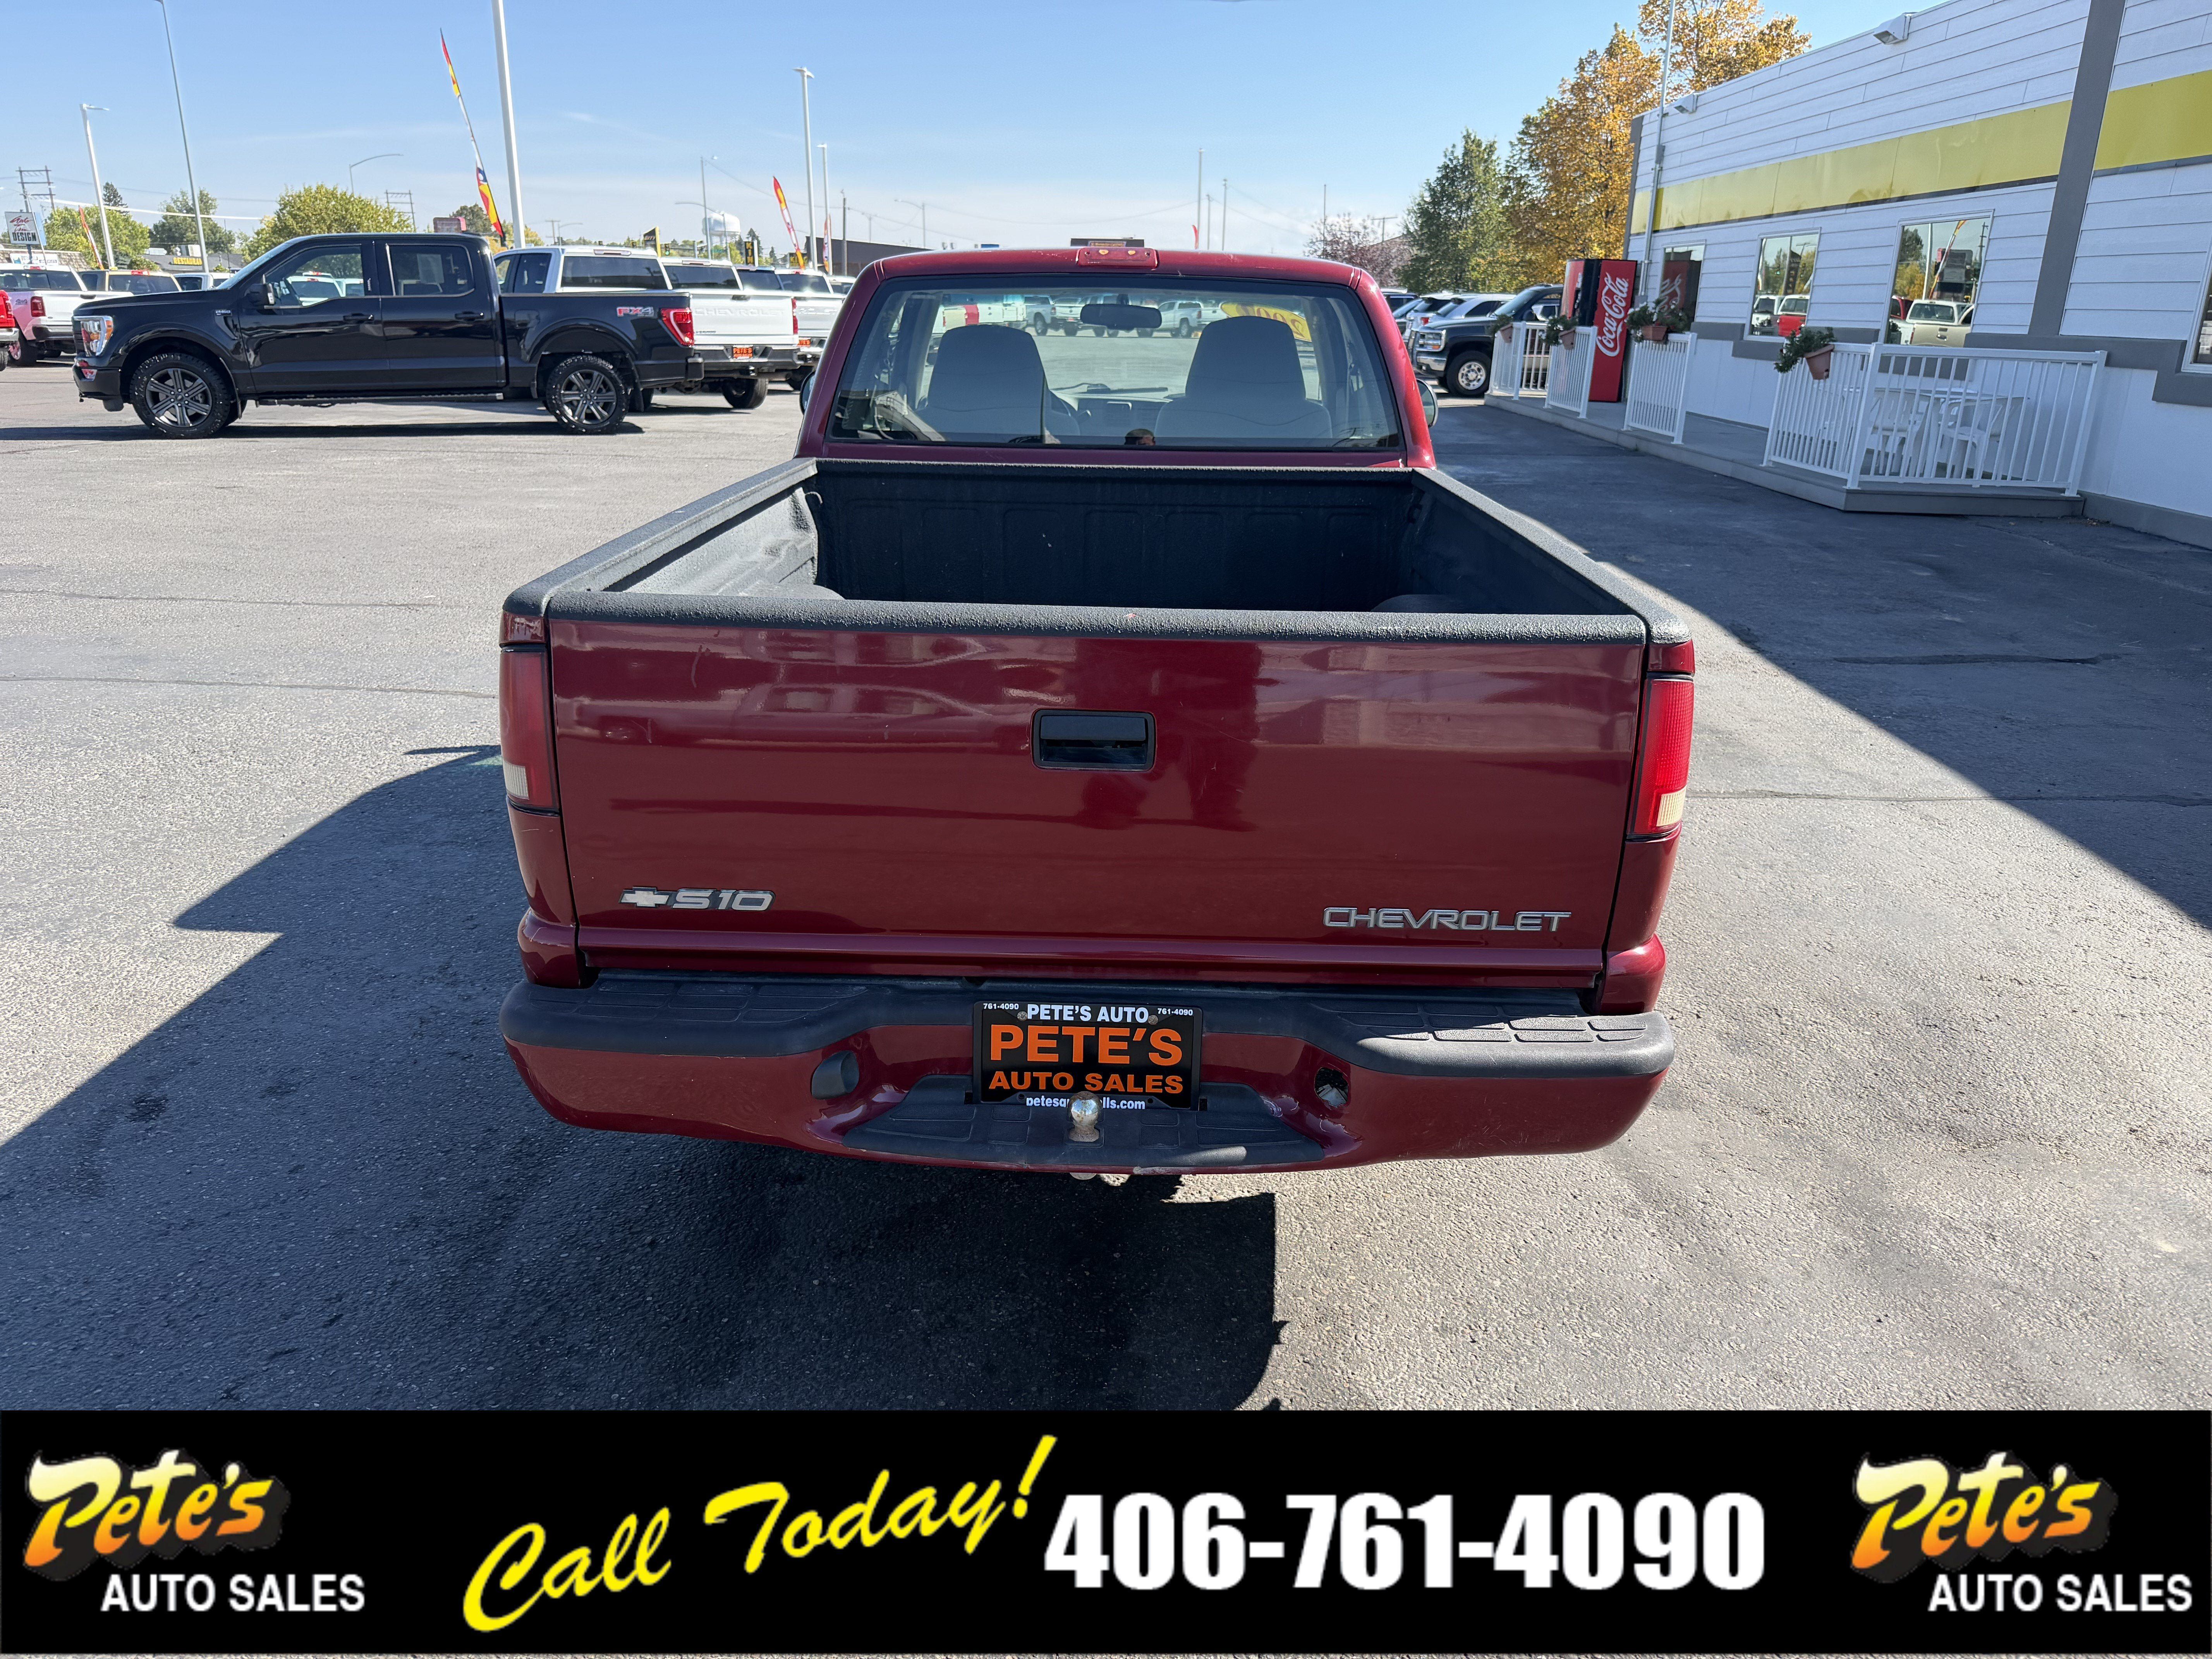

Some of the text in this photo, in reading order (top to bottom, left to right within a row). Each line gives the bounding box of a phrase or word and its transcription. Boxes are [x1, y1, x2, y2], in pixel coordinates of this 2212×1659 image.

[12, 232, 36, 241] DESIGN
[617, 307, 654, 317] FX4
[1596, 272, 1629, 357] Coca-Cola
[672, 888, 775, 911] S10
[1324, 907, 1571, 932] CHEVROLET
[1027, 1004, 1149, 1023] PETE'S AUTO
[1158, 1008, 1193, 1016] 761-4090
[991, 1024, 1182, 1066] PETE'S
[989, 1071, 1183, 1094] AUTO SALES
